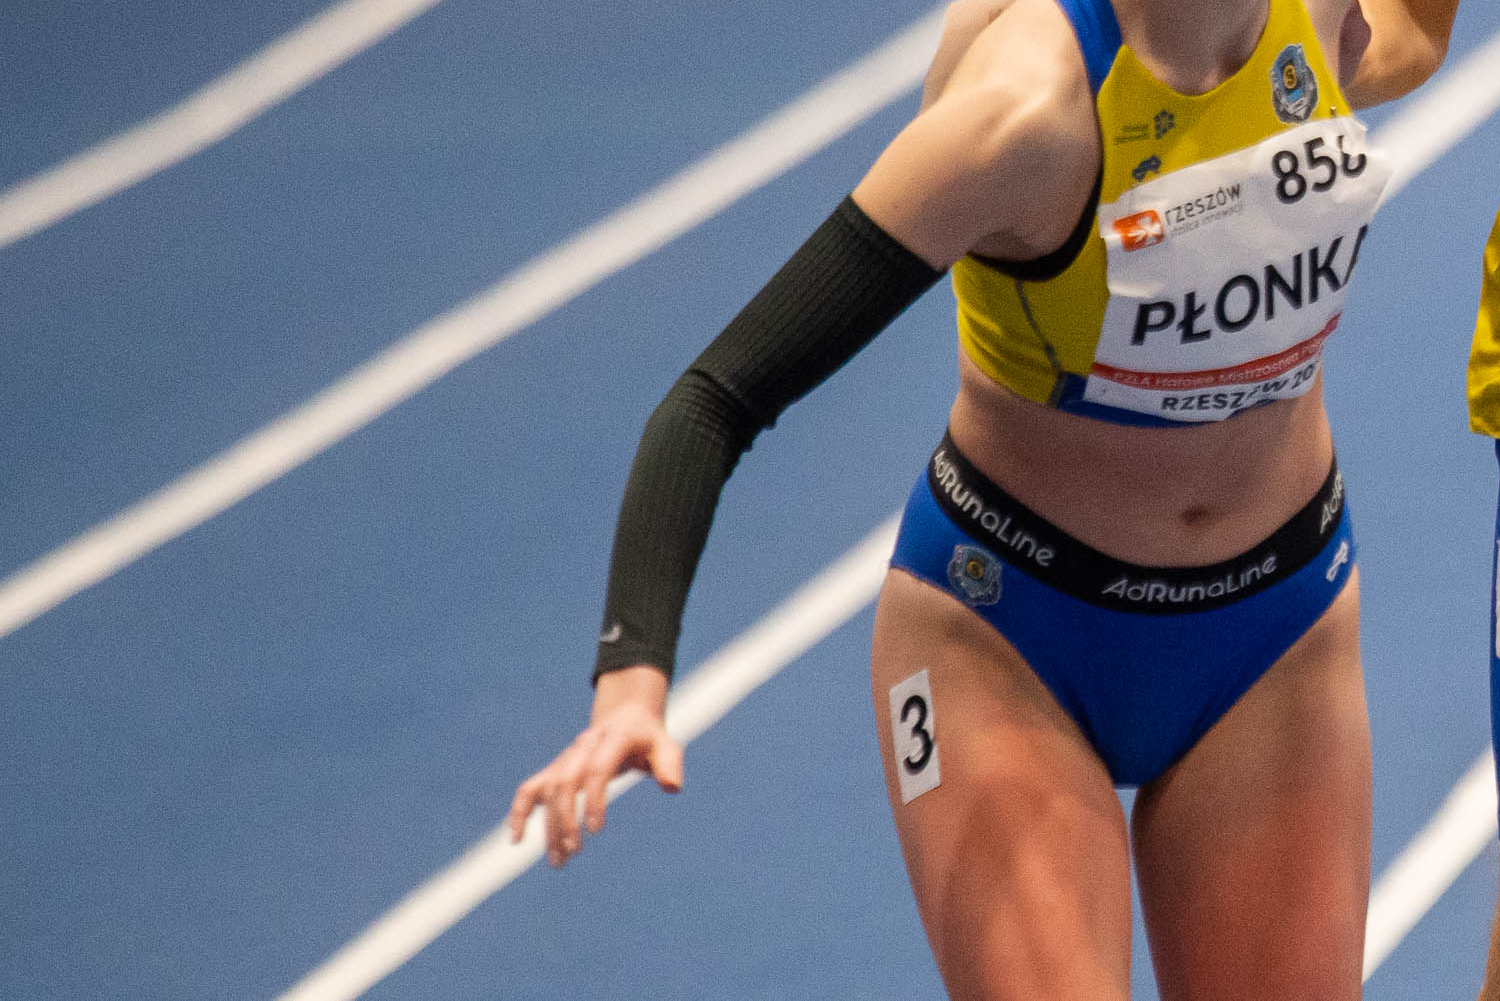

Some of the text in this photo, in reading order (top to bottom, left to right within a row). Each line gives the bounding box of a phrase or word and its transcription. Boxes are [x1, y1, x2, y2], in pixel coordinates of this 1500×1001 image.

[1164, 182, 1241, 226] rzeszów
[933, 449, 1054, 567] AdRunaLine
[1102, 553, 1278, 604] AdRunaLine
[900, 694, 934, 775] 3
